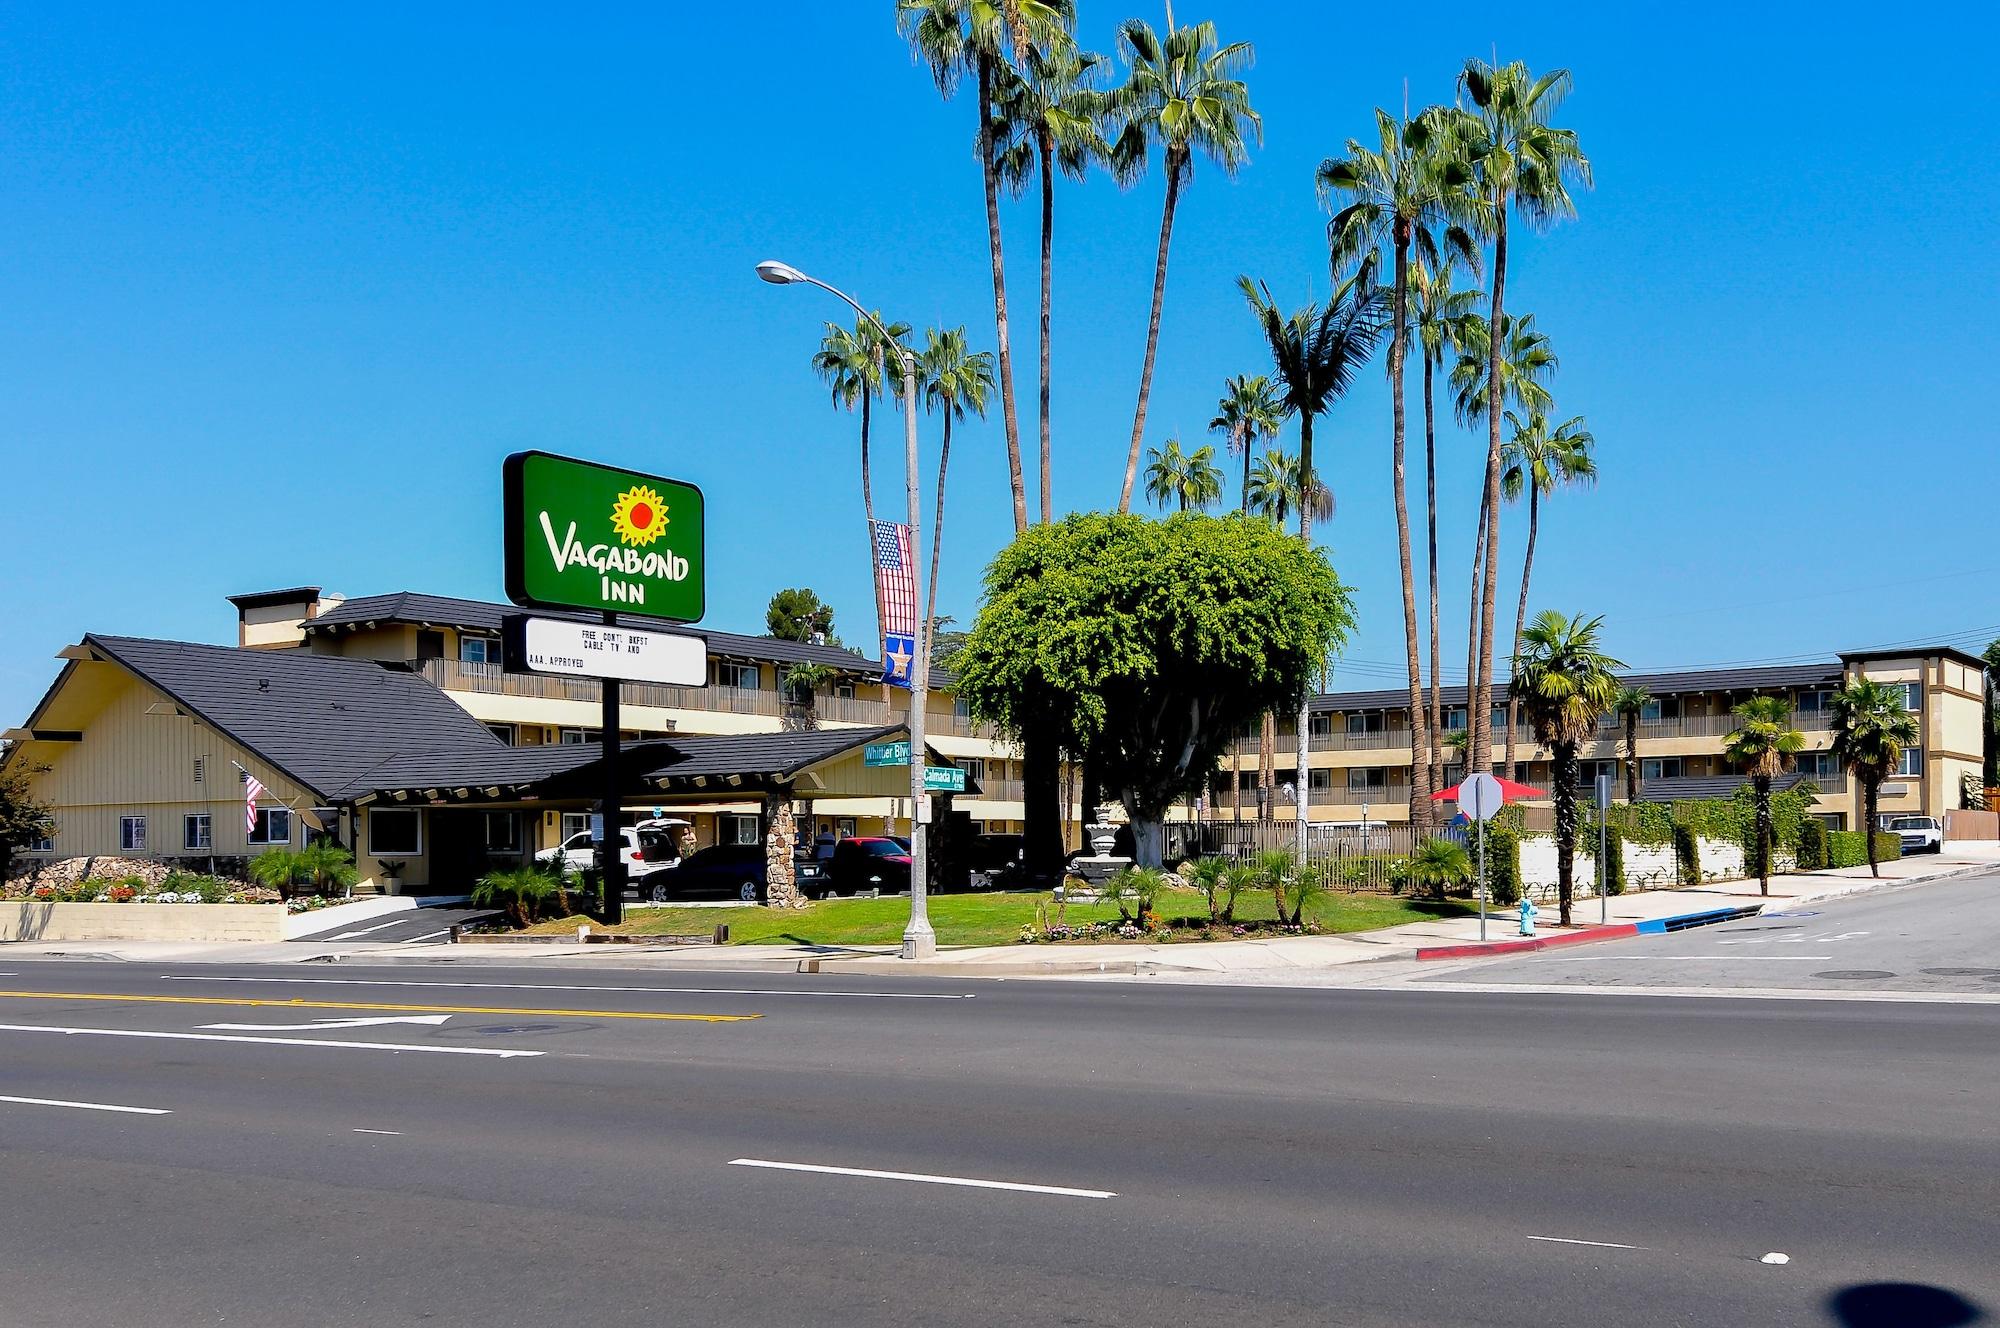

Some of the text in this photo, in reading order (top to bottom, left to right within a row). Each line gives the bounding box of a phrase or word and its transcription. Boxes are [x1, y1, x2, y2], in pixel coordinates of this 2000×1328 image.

[539, 510, 689, 581] VAGABOND
[602, 576, 645, 605] INN
[582, 630, 596, 640] FREE
[629, 636, 649, 646] BKFST
[584, 640, 640, 654] CABLE TV AND
[866, 745, 911, 760] Whittier Blvd
[952, 770, 964, 783] Ave
